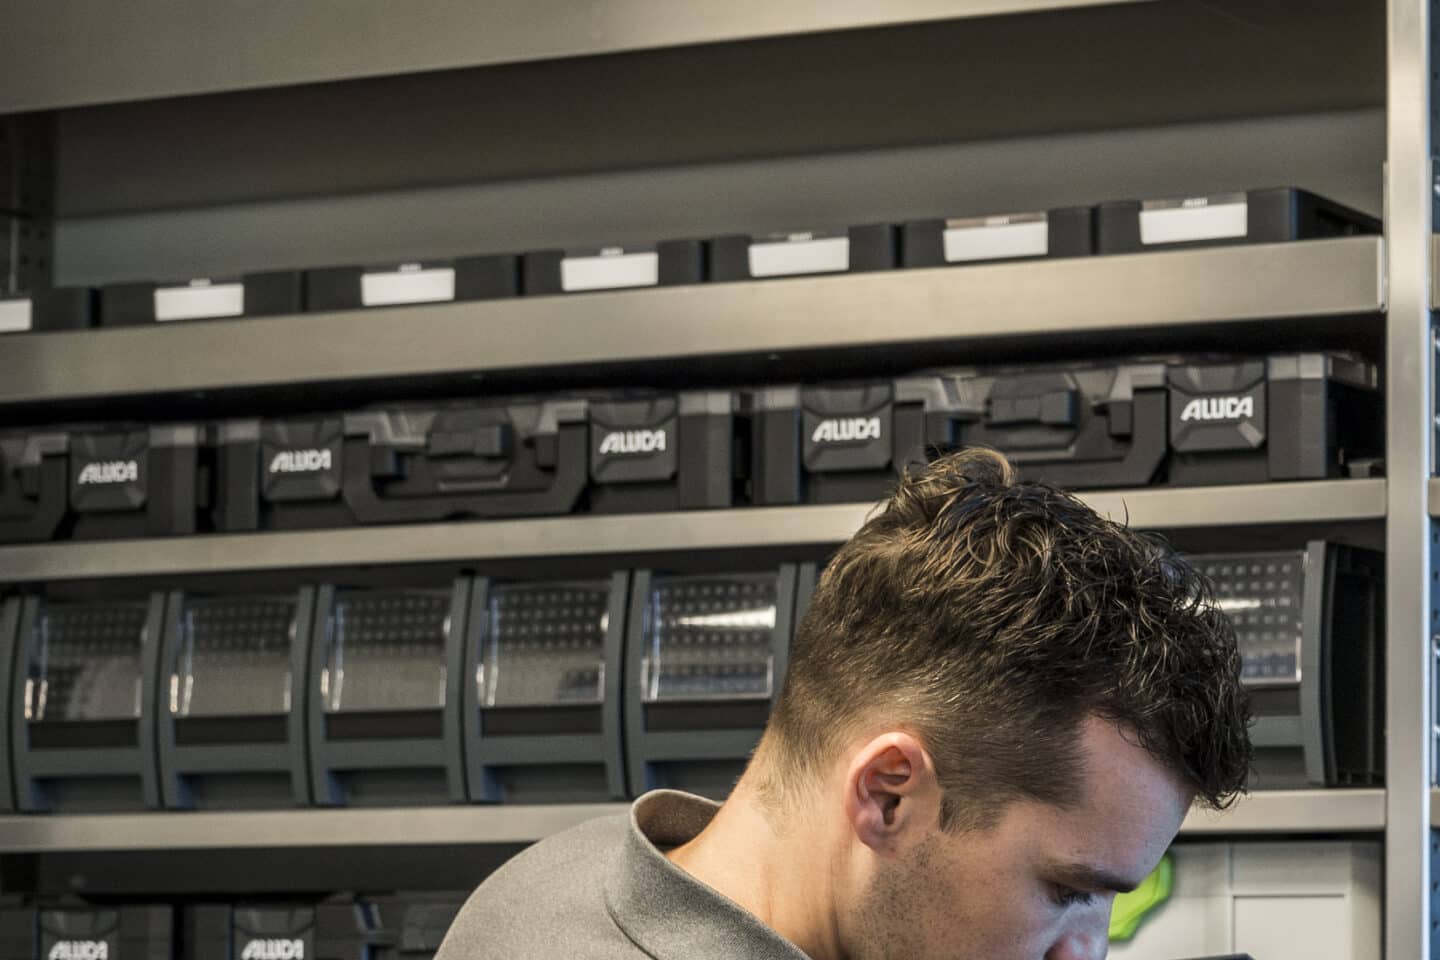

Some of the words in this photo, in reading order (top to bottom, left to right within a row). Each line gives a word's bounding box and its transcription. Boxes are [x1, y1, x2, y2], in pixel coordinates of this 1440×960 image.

[1180, 396, 1254, 421] ALUCA
[599, 429, 666, 455] ALUCA
[812, 417, 881, 442] ALUCA
[78, 460, 138, 485] ALUCA
[270, 449, 332, 474] ALUCA
[241, 938, 304, 960] ALUCA
